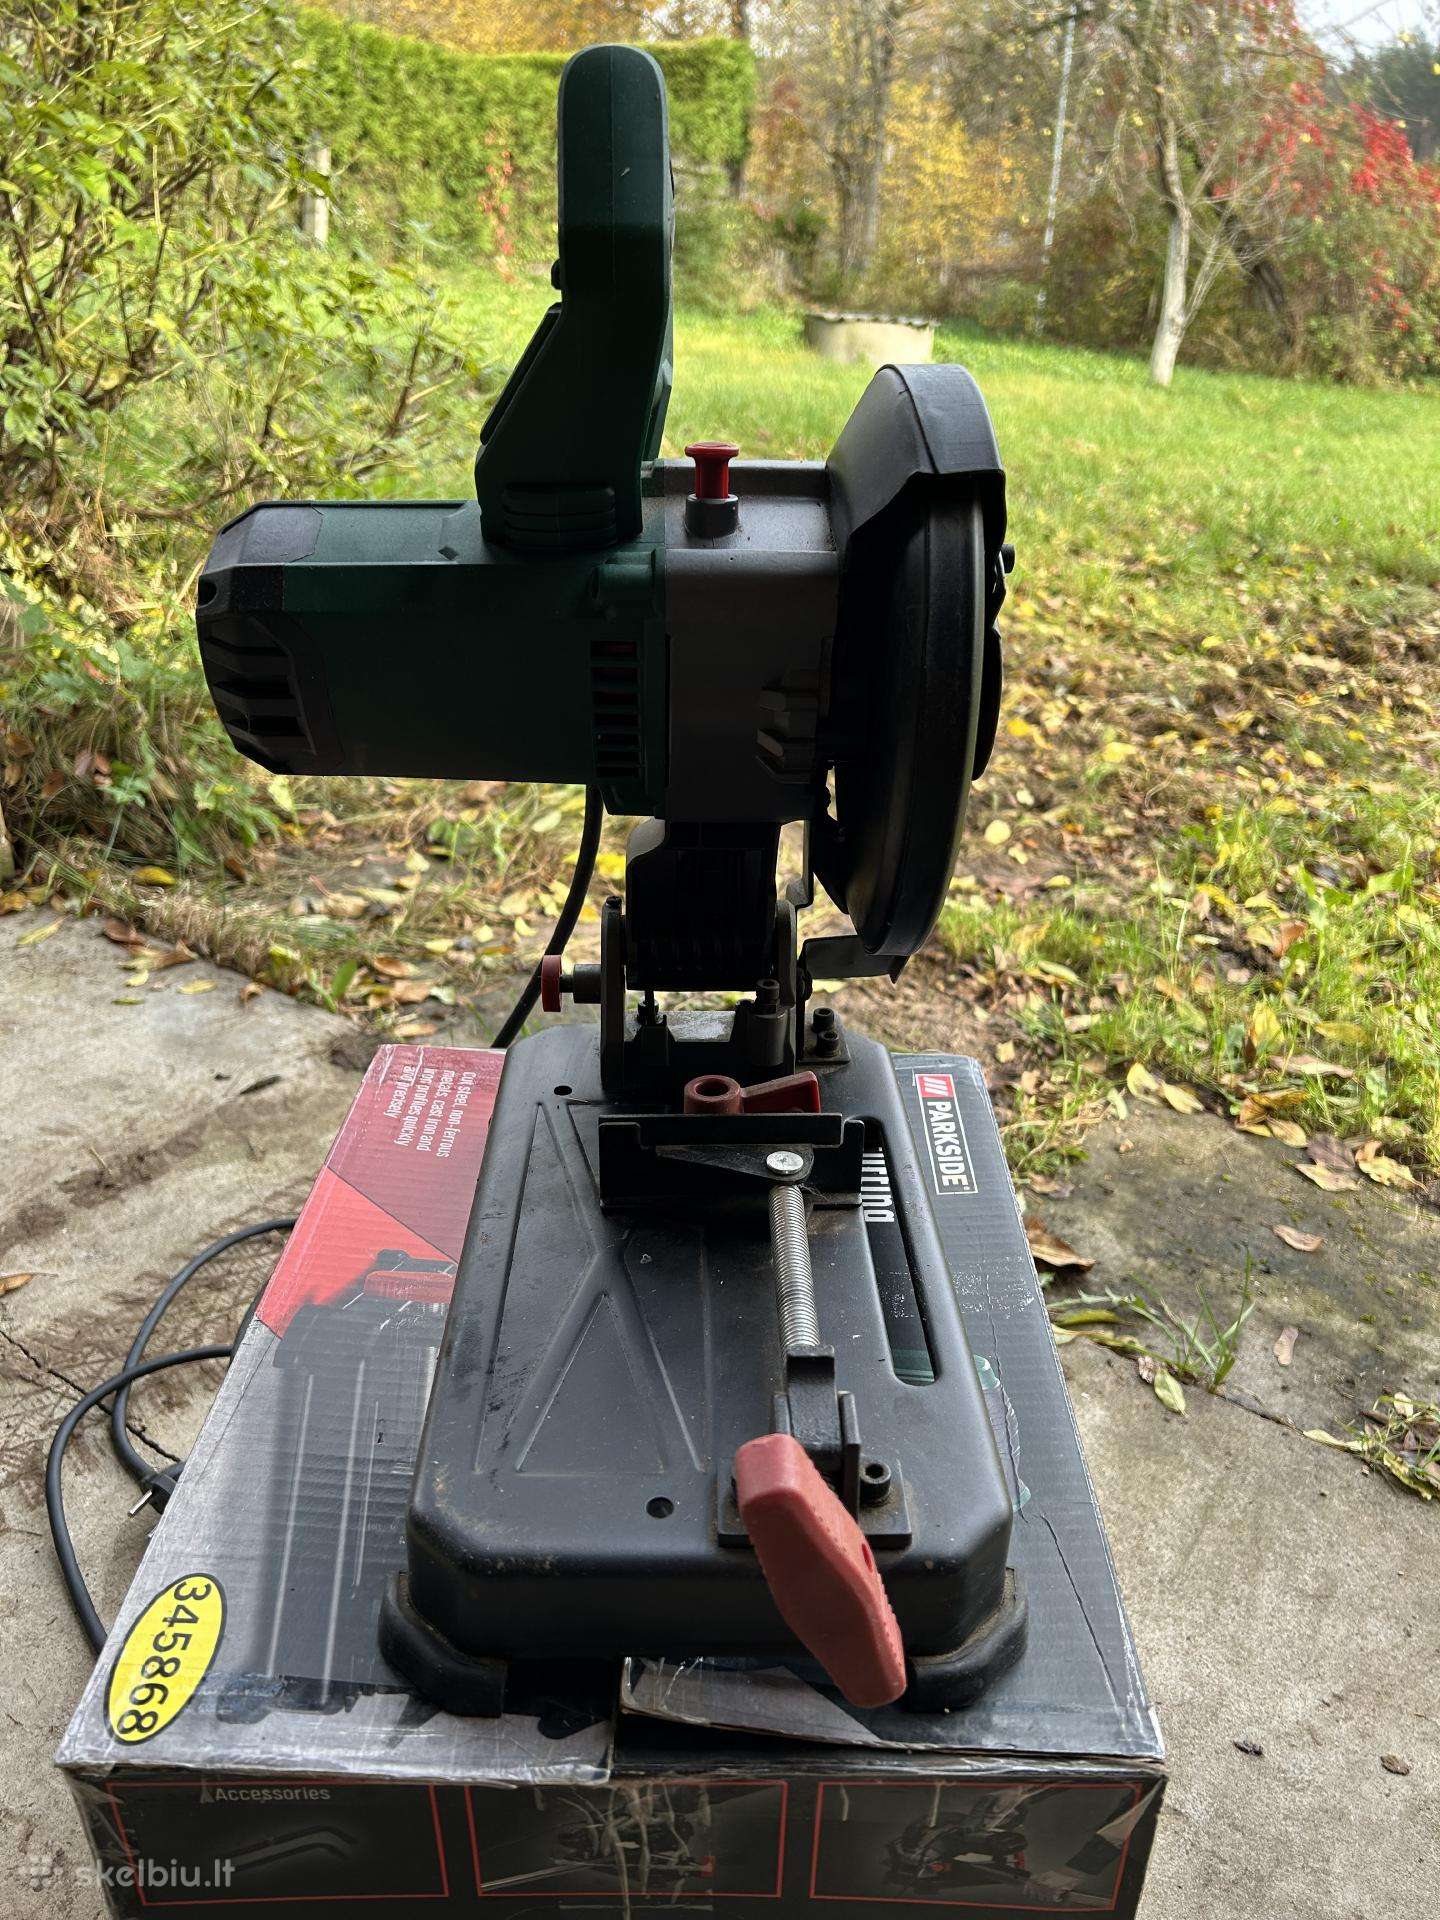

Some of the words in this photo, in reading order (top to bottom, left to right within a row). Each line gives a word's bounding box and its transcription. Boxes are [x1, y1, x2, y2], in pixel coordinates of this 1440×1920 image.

[420, 1068, 435, 1085] iron
[383, 1080, 410, 1119] precisely
[408, 1084, 429, 1115] profiles
[429, 1099, 445, 1118] cast
[394, 1115, 418, 1147] quickly
[423, 1116, 441, 1136] iron
[436, 1109, 463, 1158] non-ferrous
[416, 1135, 433, 1152] and
[926, 1101, 969, 1187] PARKSIDE
[116, 1580, 211, 1735] 345868
[215, 1786, 331, 1802] Accessories
